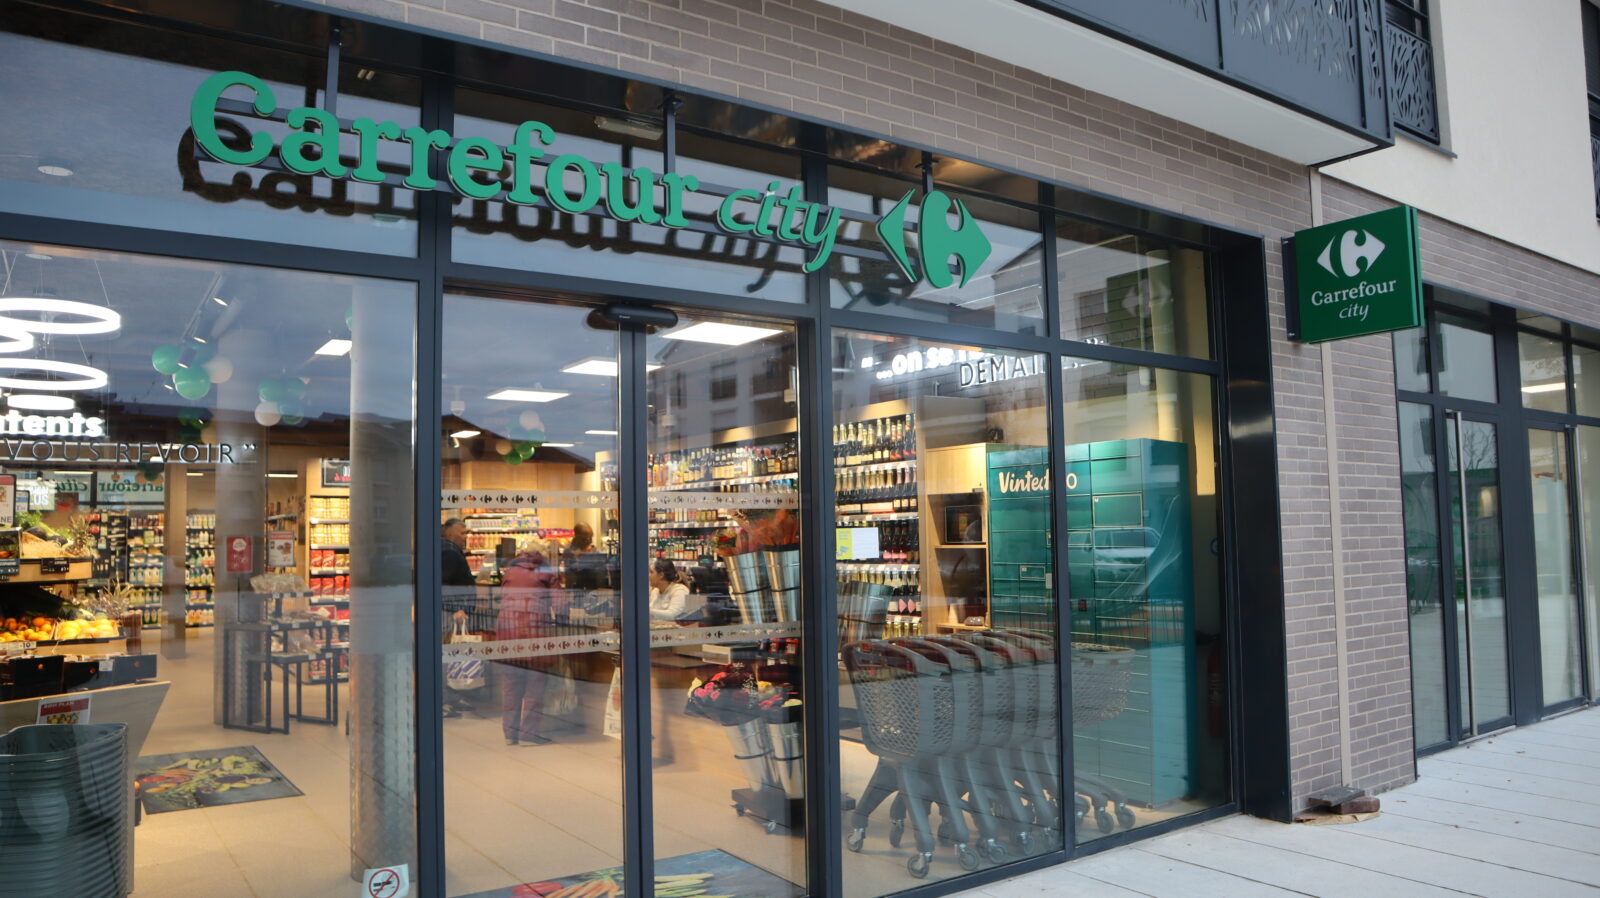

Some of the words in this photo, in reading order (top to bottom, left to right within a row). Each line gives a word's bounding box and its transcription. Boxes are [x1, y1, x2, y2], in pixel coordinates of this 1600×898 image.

[191, 71, 699, 228] Carrefour
[717, 181, 840, 273] city
[1311, 280, 1396, 306] Carrefour
[1339, 303, 1369, 322] city
[959, 353, 1047, 387] DEMAI
[0, 410, 105, 437] tents
[4, 438, 102, 460] VOUS
[116, 441, 234, 463] REVOIR
[998, 468, 1050, 494] Vinted
